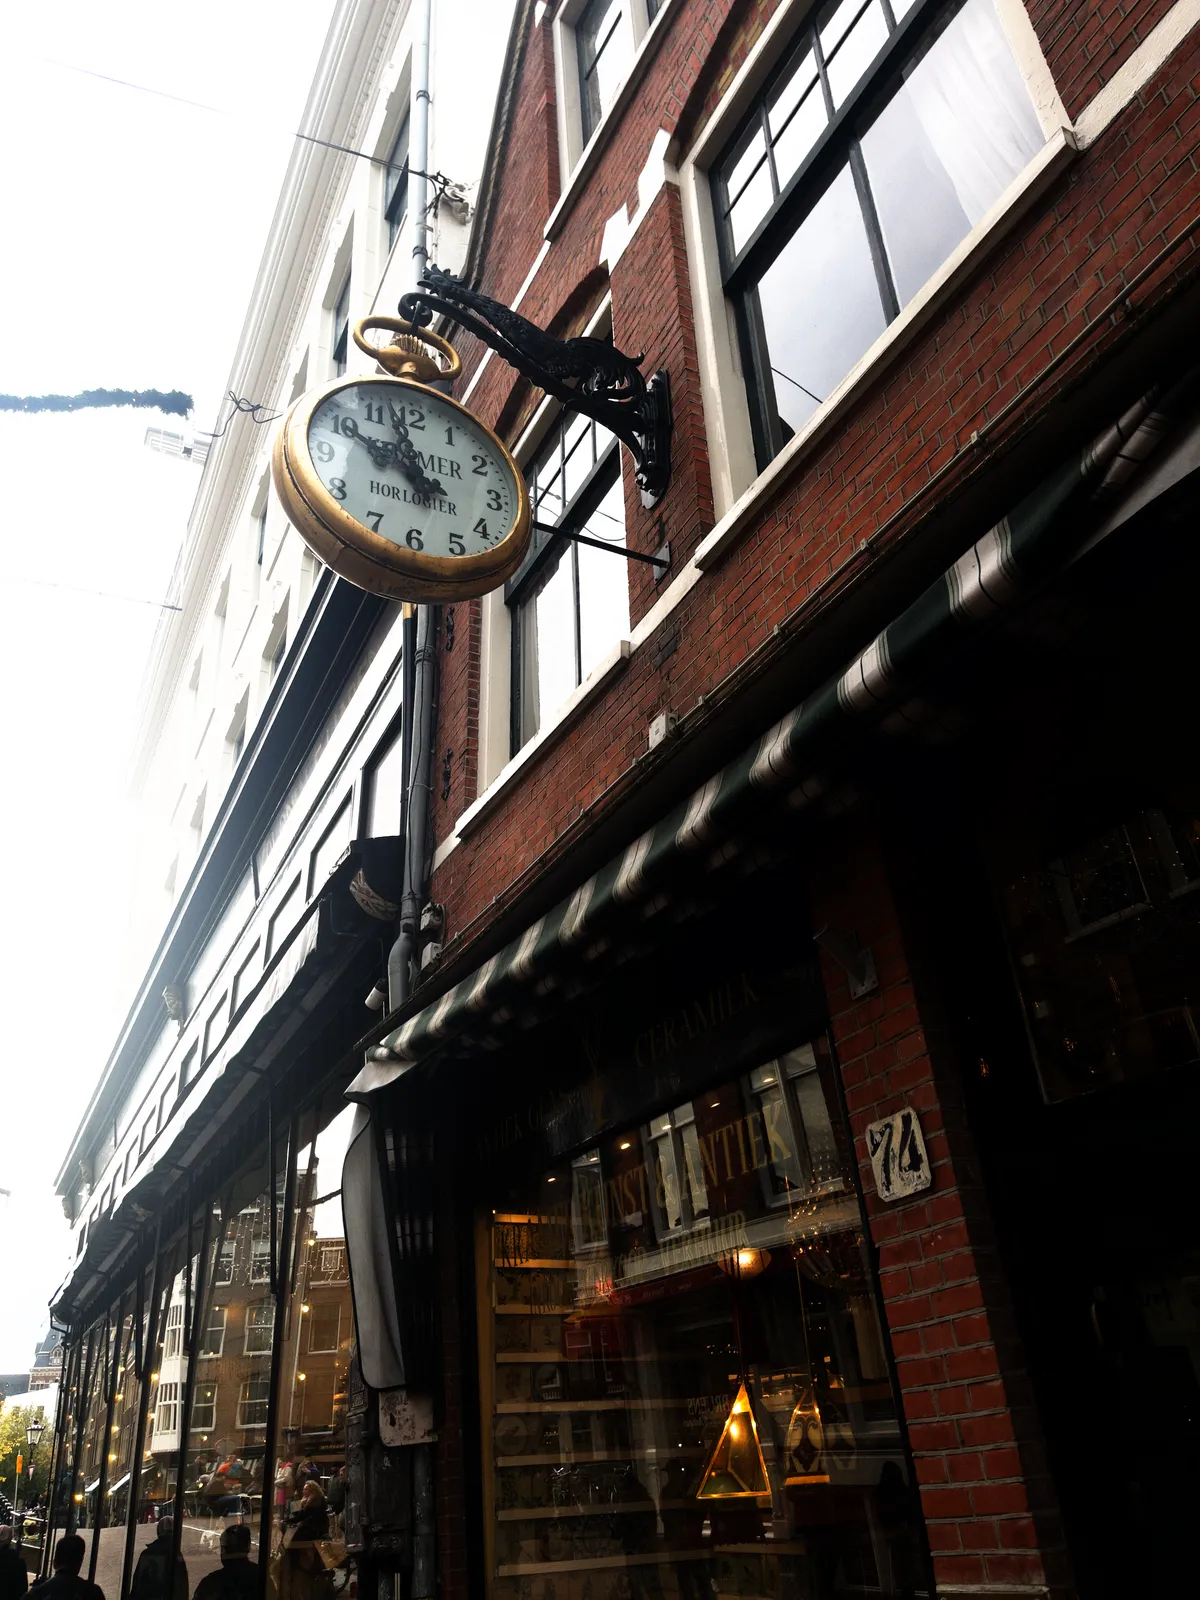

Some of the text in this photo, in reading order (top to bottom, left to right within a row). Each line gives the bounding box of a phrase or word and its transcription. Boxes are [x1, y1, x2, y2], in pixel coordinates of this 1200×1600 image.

[331, 414, 359, 438] 10
[364, 402, 386, 426] 11
[397, 406, 426, 431] 12
[444, 426, 456, 447] 1
[316, 441, 335, 463] 9
[366, 435, 464, 482] MER
[471, 454, 489, 477] 2
[328, 477, 347, 501] 8
[369, 480, 459, 517] HORLOGIER
[486, 489, 503, 511] 3
[365, 511, 385, 534] 7
[472, 517, 491, 540] 4
[405, 528, 424, 552] 6
[448, 532, 467, 556] 5
[681, 1099, 793, 1200] ANTIEK
